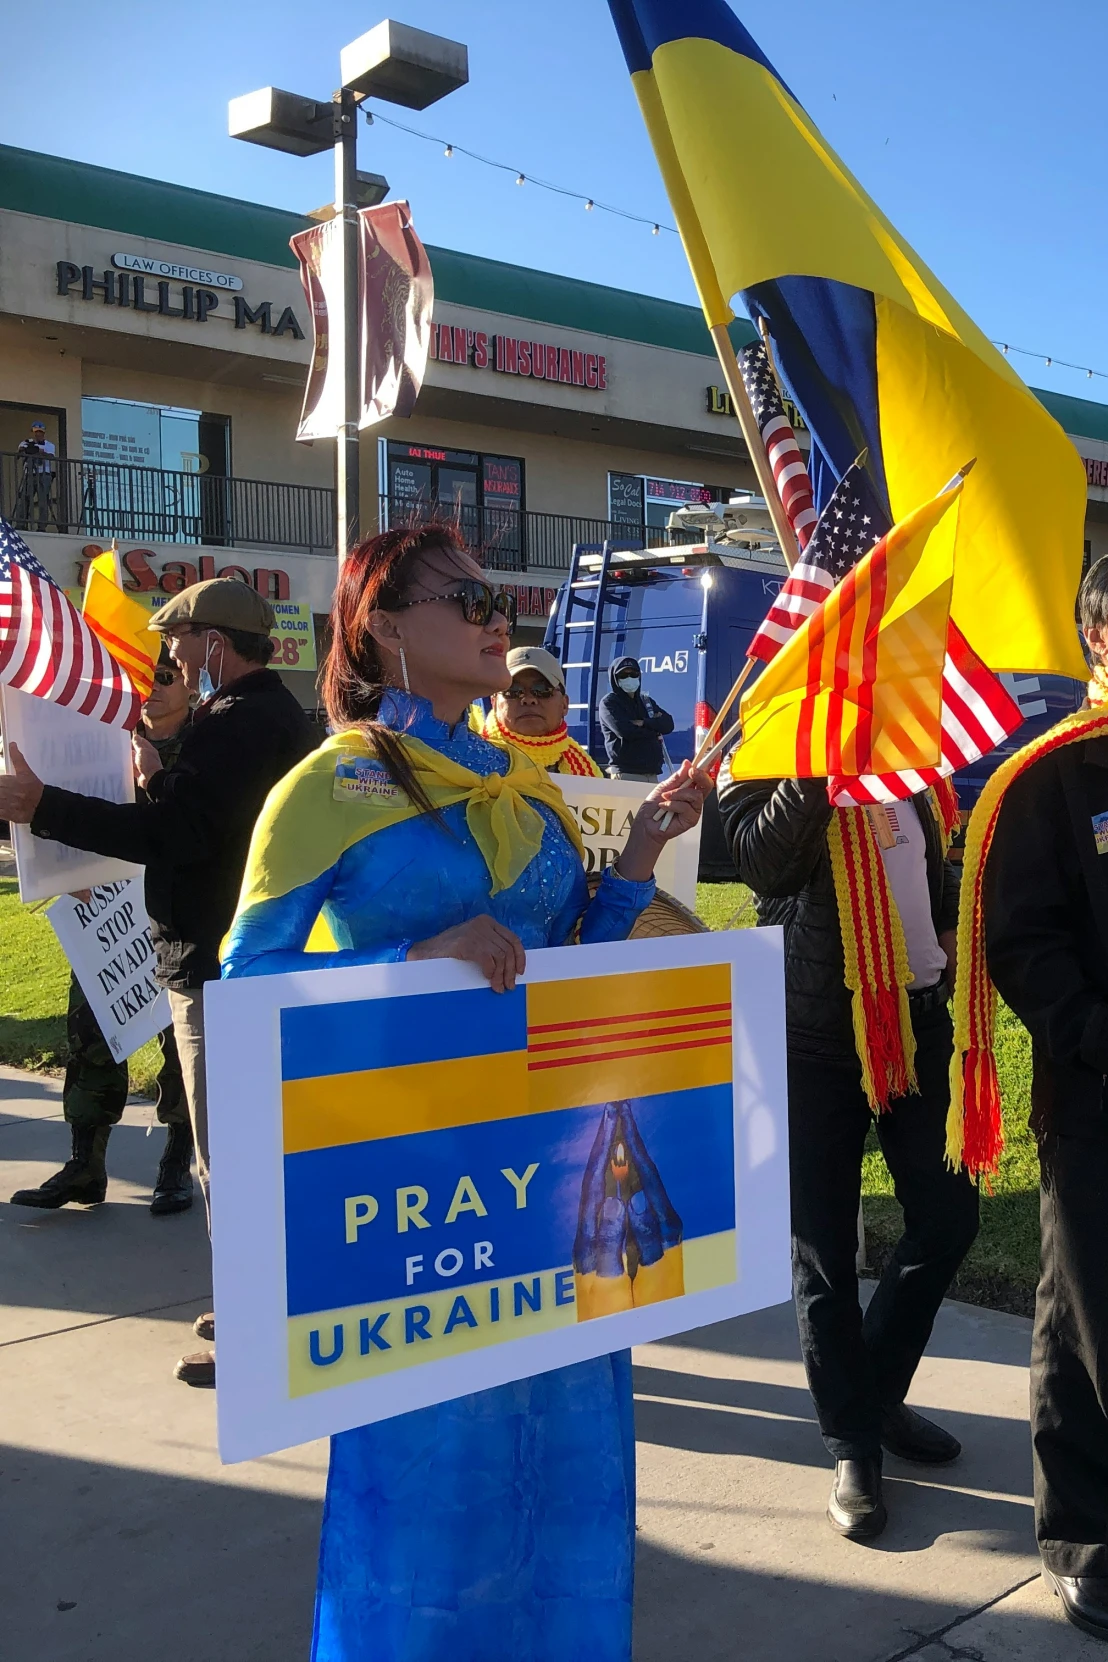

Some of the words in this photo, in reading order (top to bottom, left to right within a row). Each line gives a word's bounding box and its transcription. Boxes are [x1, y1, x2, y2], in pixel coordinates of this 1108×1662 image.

[123, 255, 155, 271] LAW
[159, 263, 213, 284] OFFICES
[216, 275, 236, 288] OF
[57, 260, 219, 322] PHILLIP
[232, 296, 305, 340] MA
[493, 334, 608, 390] INSURANCE
[394, 475, 415, 485] Home
[395, 467, 414, 477] Auto
[485, 462, 518, 481] TAN'S
[394, 484, 418, 493] Health
[281, 620, 309, 631] COLOR
[354, 767, 392, 780] STAND
[358, 777, 387, 787] WITH
[346, 783, 399, 796] UKRAINE
[96, 900, 137, 954] STOP
[344, 1162, 541, 1244] PRAY
[405, 1240, 496, 1286] FOR
[308, 1270, 577, 1367] UKRAINE
